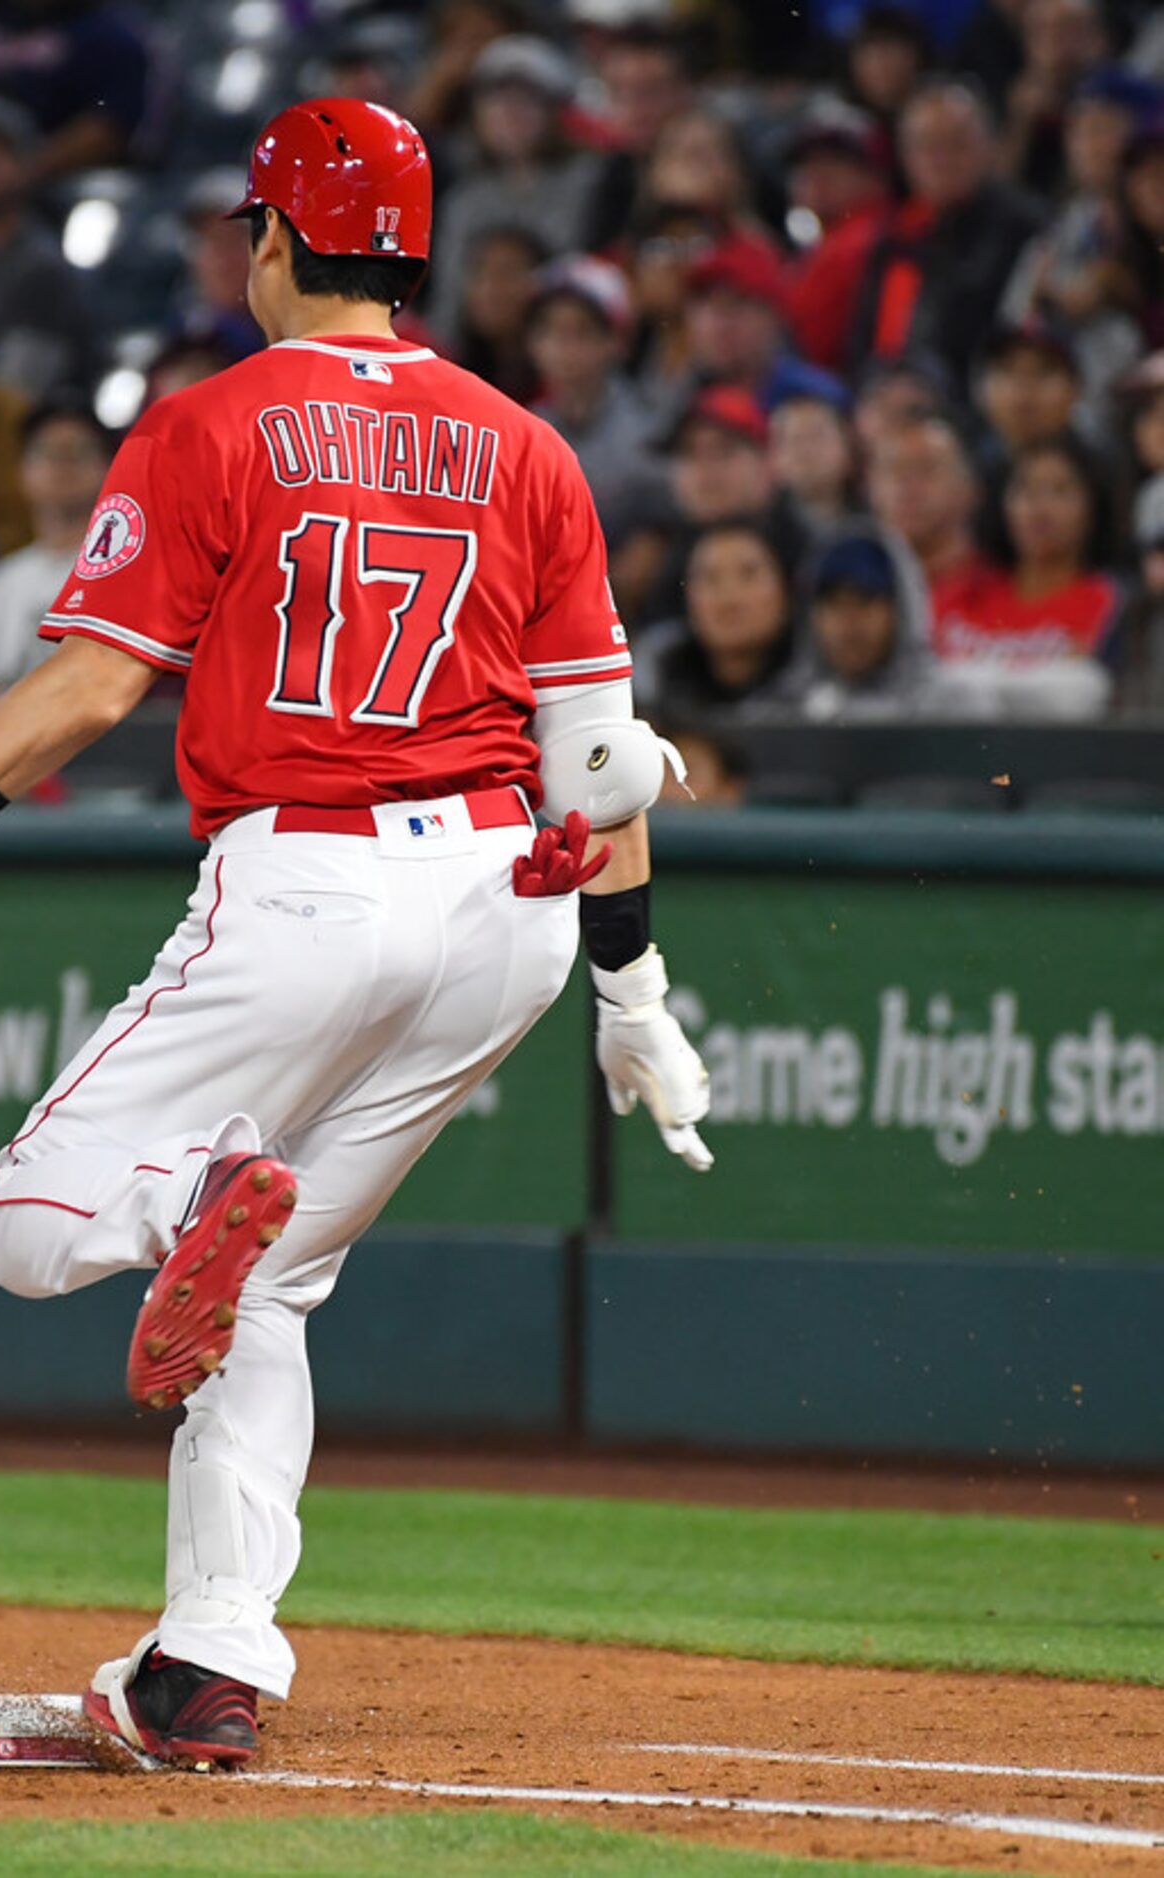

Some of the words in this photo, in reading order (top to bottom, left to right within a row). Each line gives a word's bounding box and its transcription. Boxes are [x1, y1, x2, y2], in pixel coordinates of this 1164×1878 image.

[376, 206, 401, 232] 17
[258, 401, 498, 505] OHTANI
[266, 512, 477, 728] 17
[872, 986, 1035, 1165] high
[1046, 1009, 1164, 1136] sta
